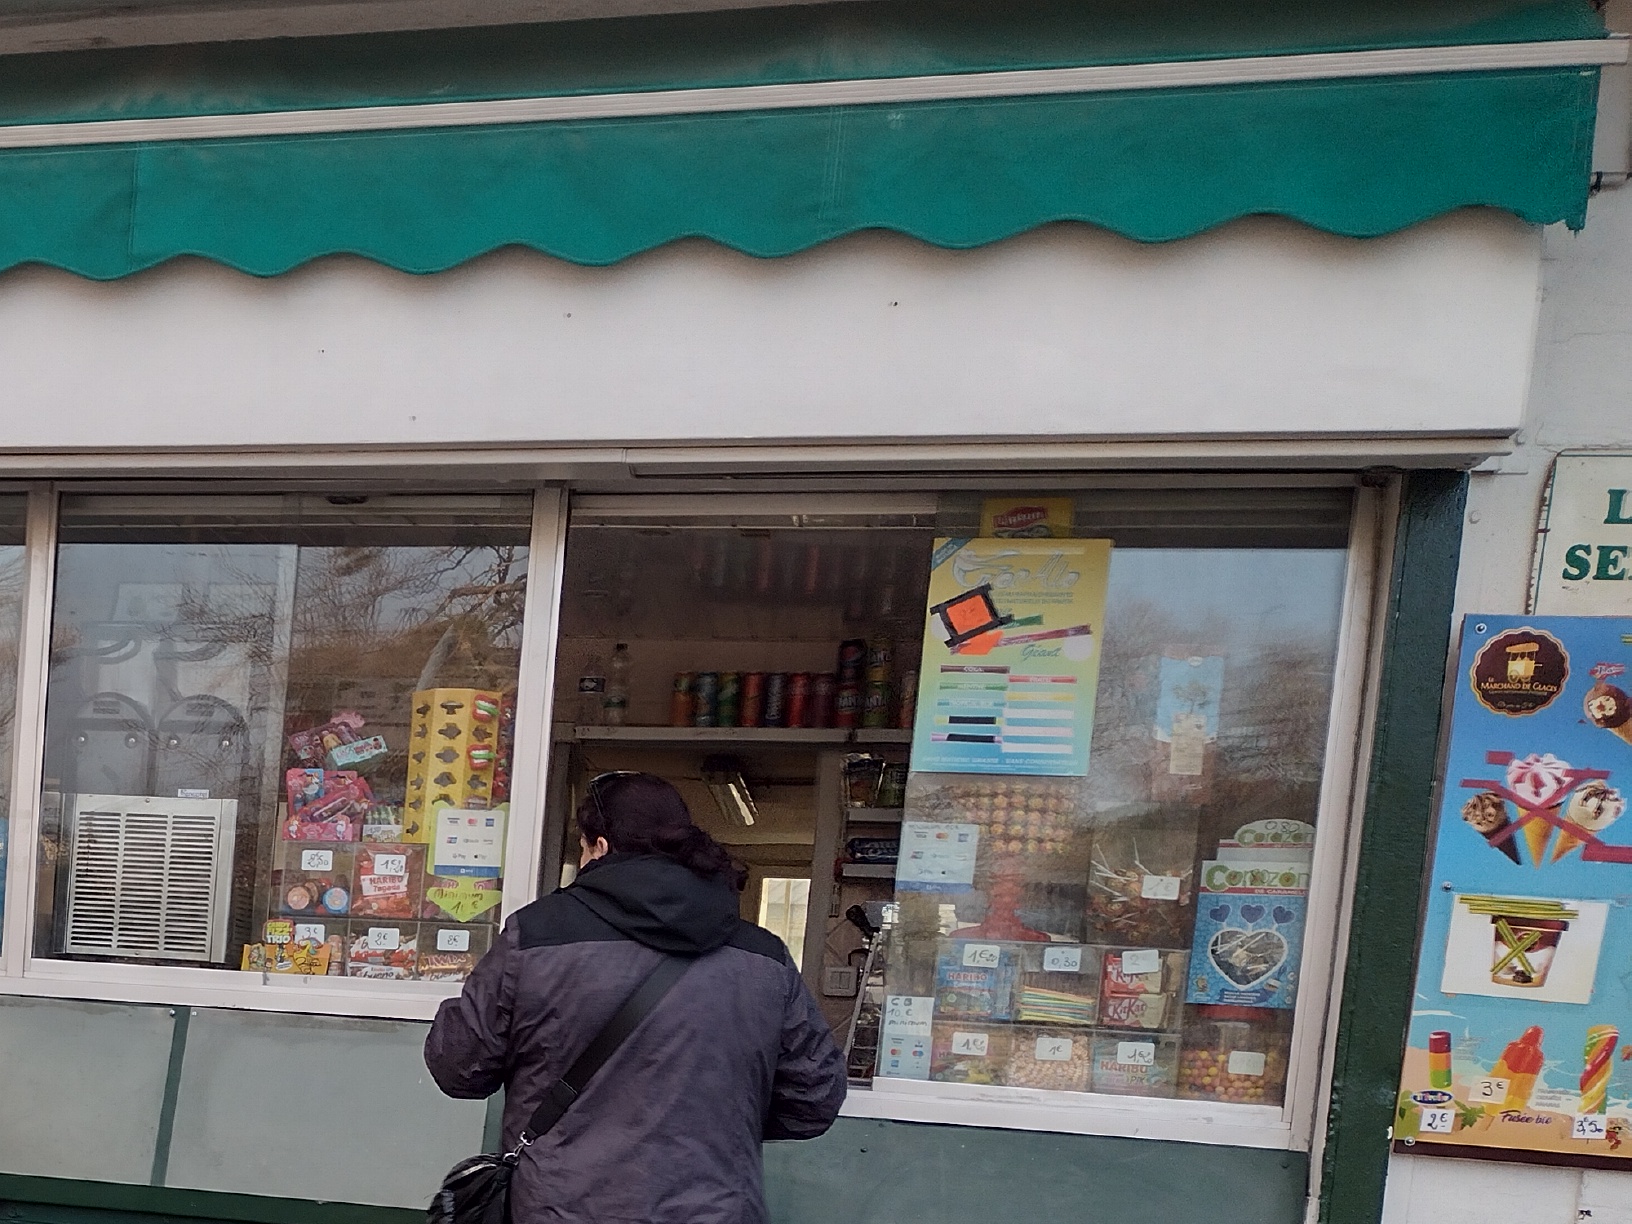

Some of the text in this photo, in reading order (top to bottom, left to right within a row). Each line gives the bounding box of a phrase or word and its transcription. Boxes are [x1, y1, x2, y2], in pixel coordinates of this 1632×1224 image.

[1562, 544, 1632, 580] SE
[369, 876, 404, 885] HARIBO
[266, 935, 291, 944] TRIO
[947, 972, 988, 981] HARIBO
[1112, 1000, 1147, 1020] KitKat
[1499, 1110, 1553, 1125] Fusée bio
